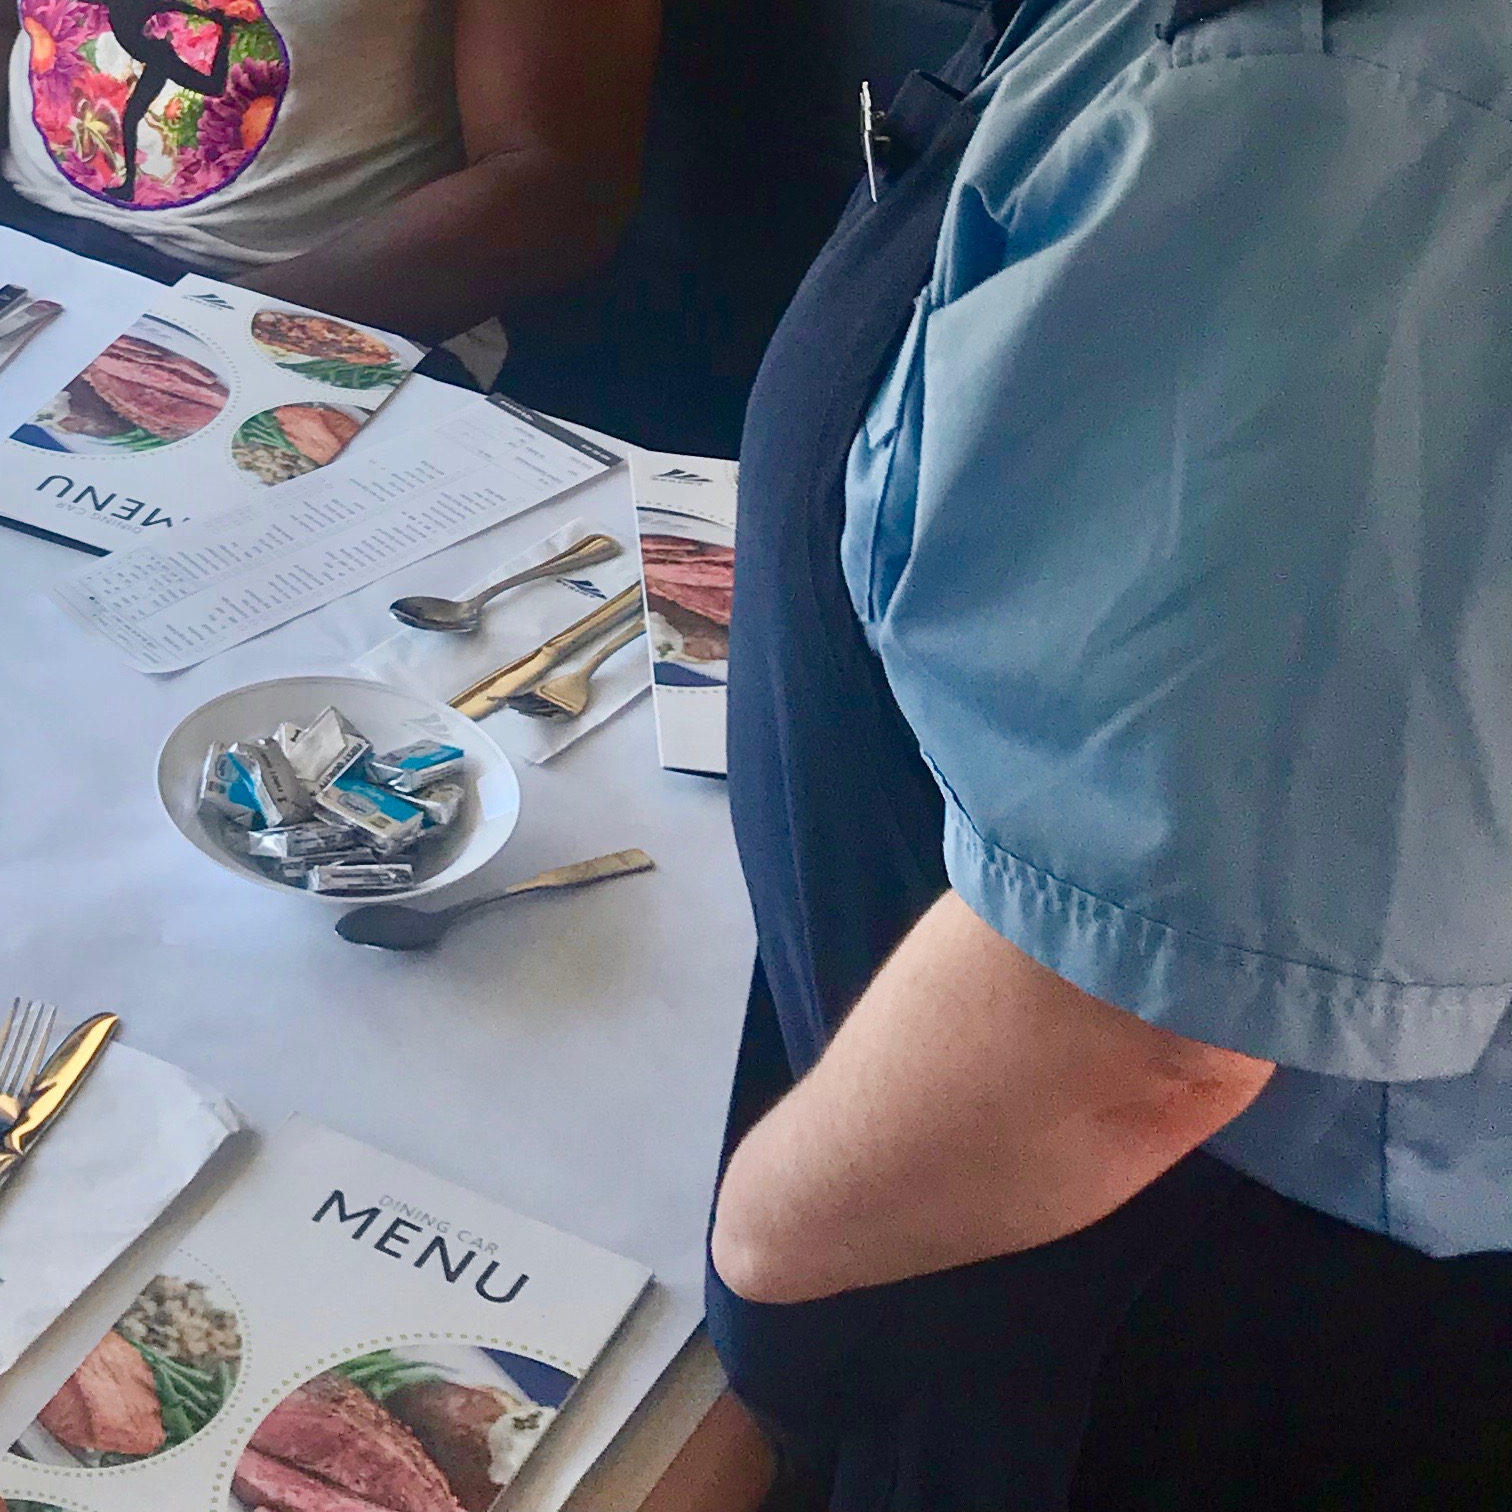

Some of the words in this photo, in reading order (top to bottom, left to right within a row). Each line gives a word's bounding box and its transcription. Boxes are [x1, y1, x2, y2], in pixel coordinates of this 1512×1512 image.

[34, 474, 191, 529] MENU
[56, 501, 87, 515] CAR
[89, 512, 144, 535] DINING
[311, 1189, 530, 1304] MENU
[378, 1194, 451, 1235] DINING
[456, 1230, 500, 1256] CAR
